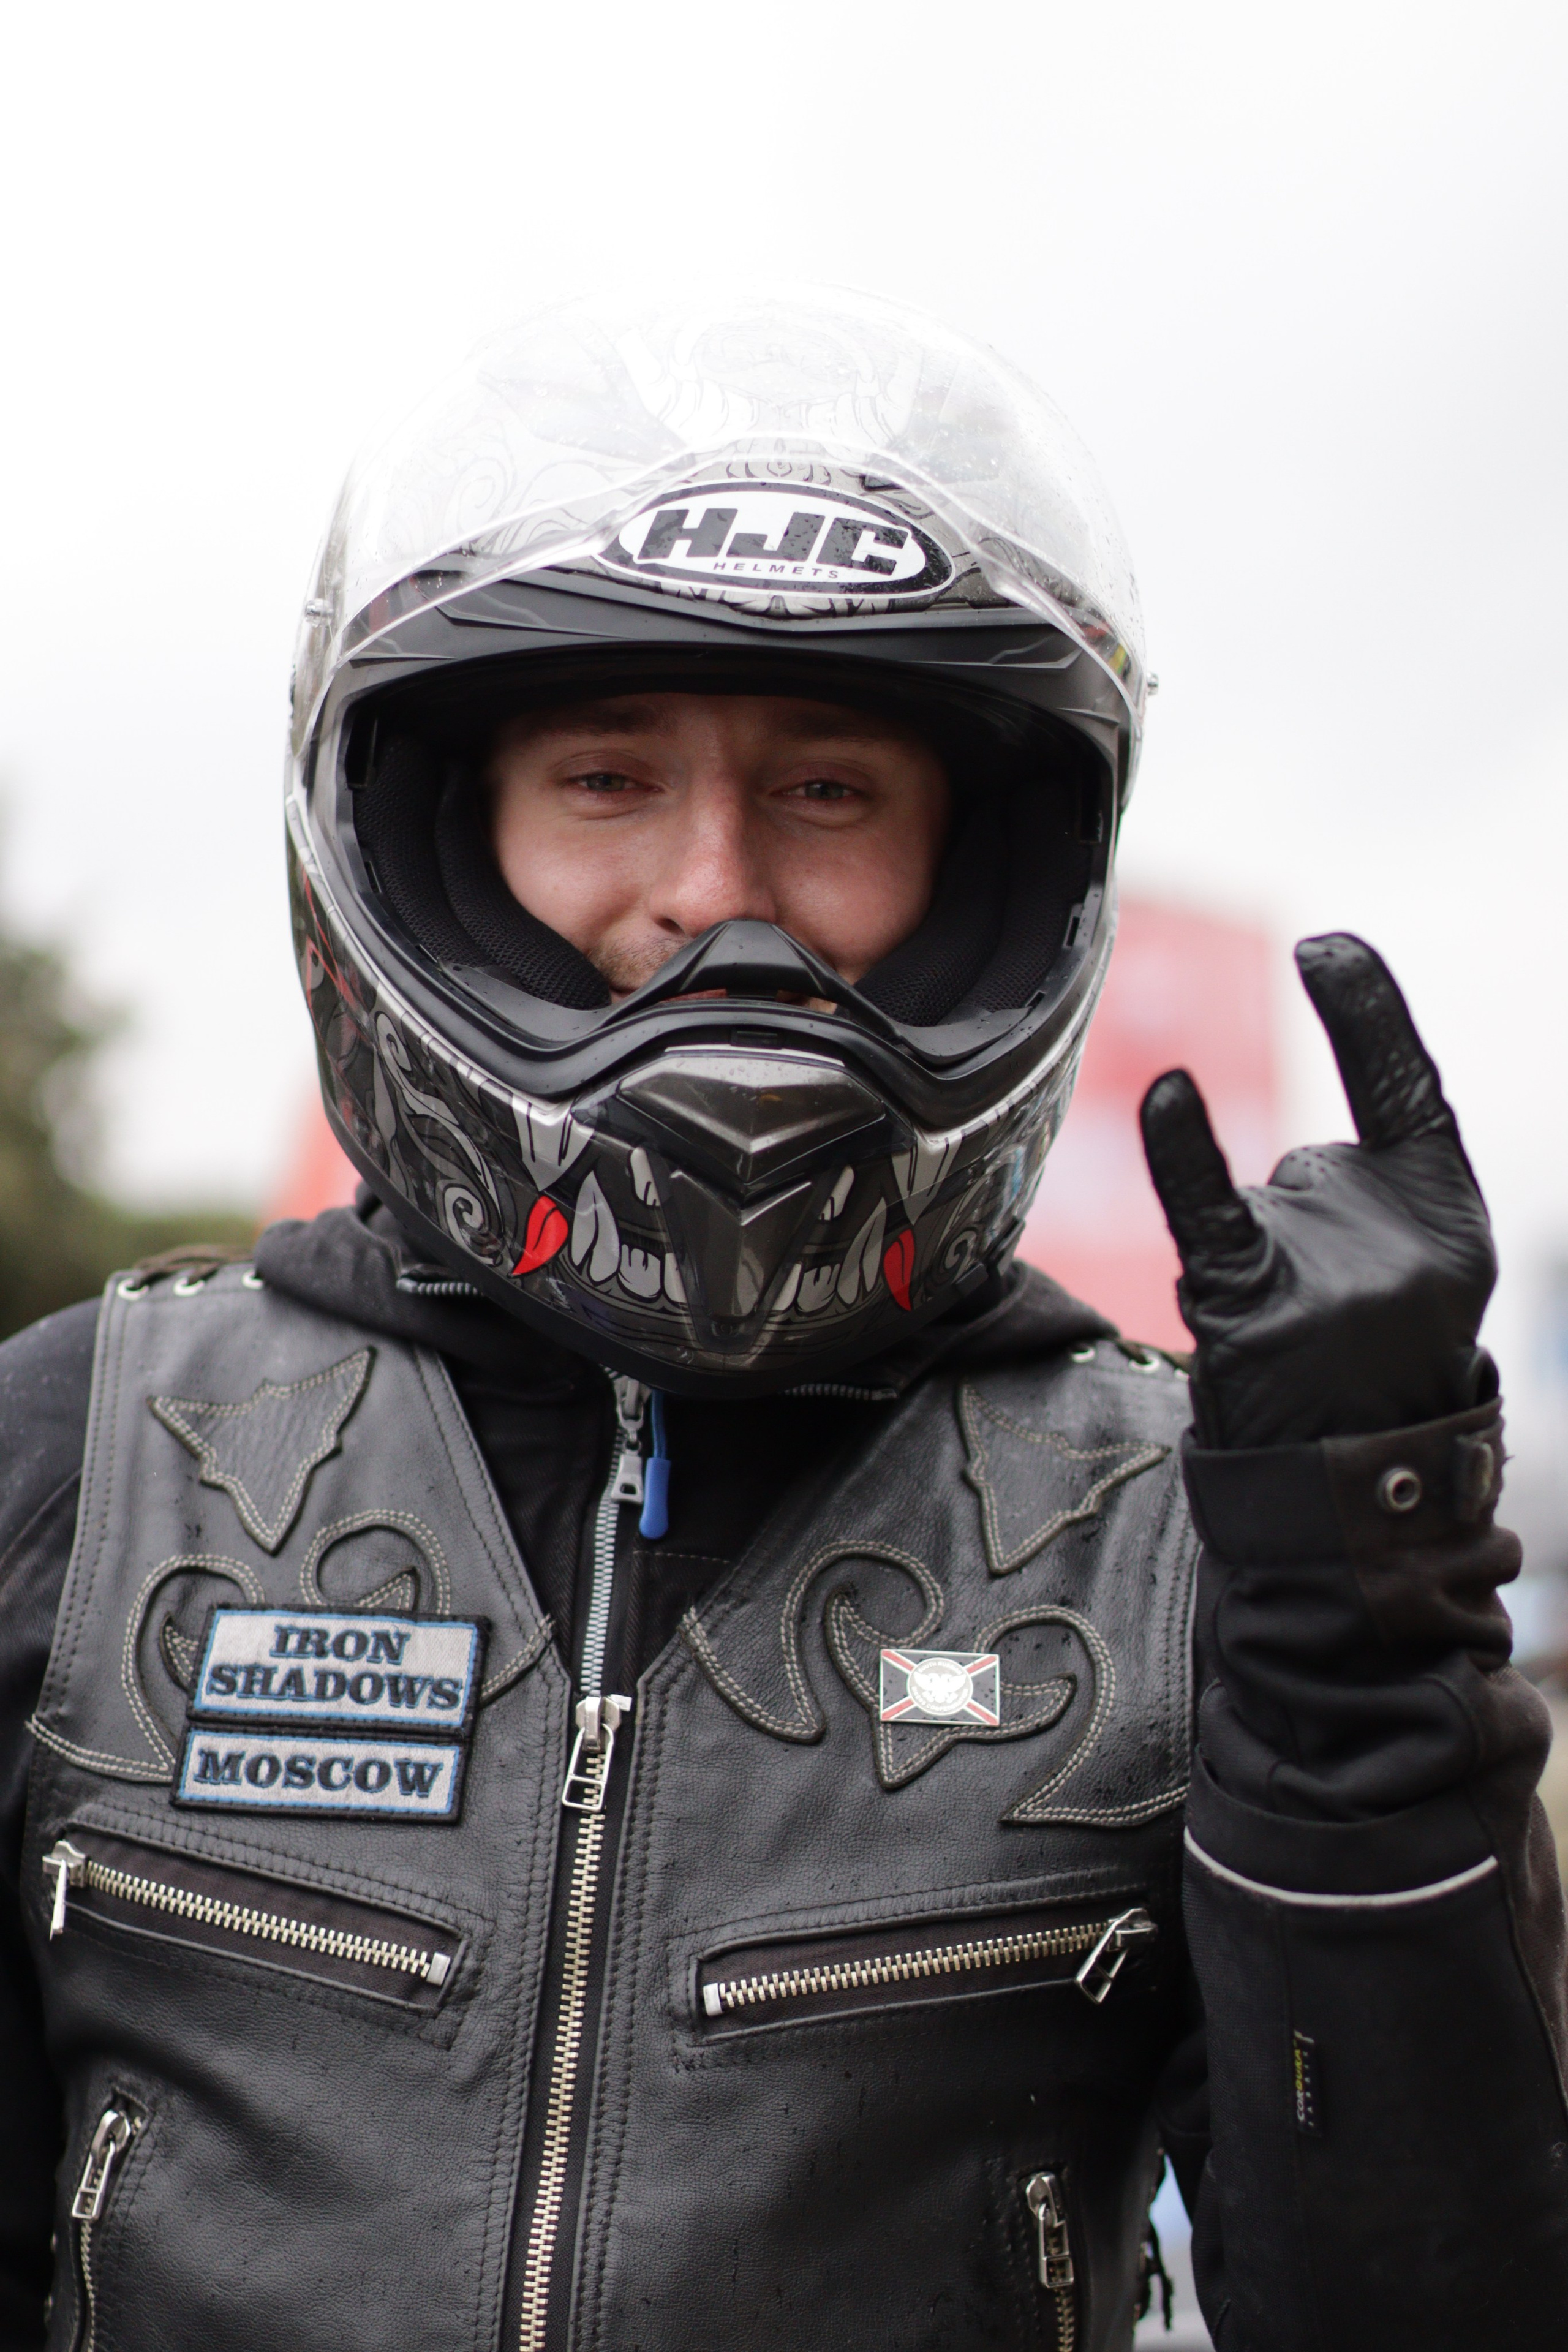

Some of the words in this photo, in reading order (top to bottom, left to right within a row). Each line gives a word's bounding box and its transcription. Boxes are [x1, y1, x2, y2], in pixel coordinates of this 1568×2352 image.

[636, 508, 911, 576] HJC
[713, 562, 839, 579] HELMETS
[270, 1624, 411, 1665] IRON
[206, 1663, 463, 1711] SHADOWS
[194, 1748, 443, 1798] MOSCOW
